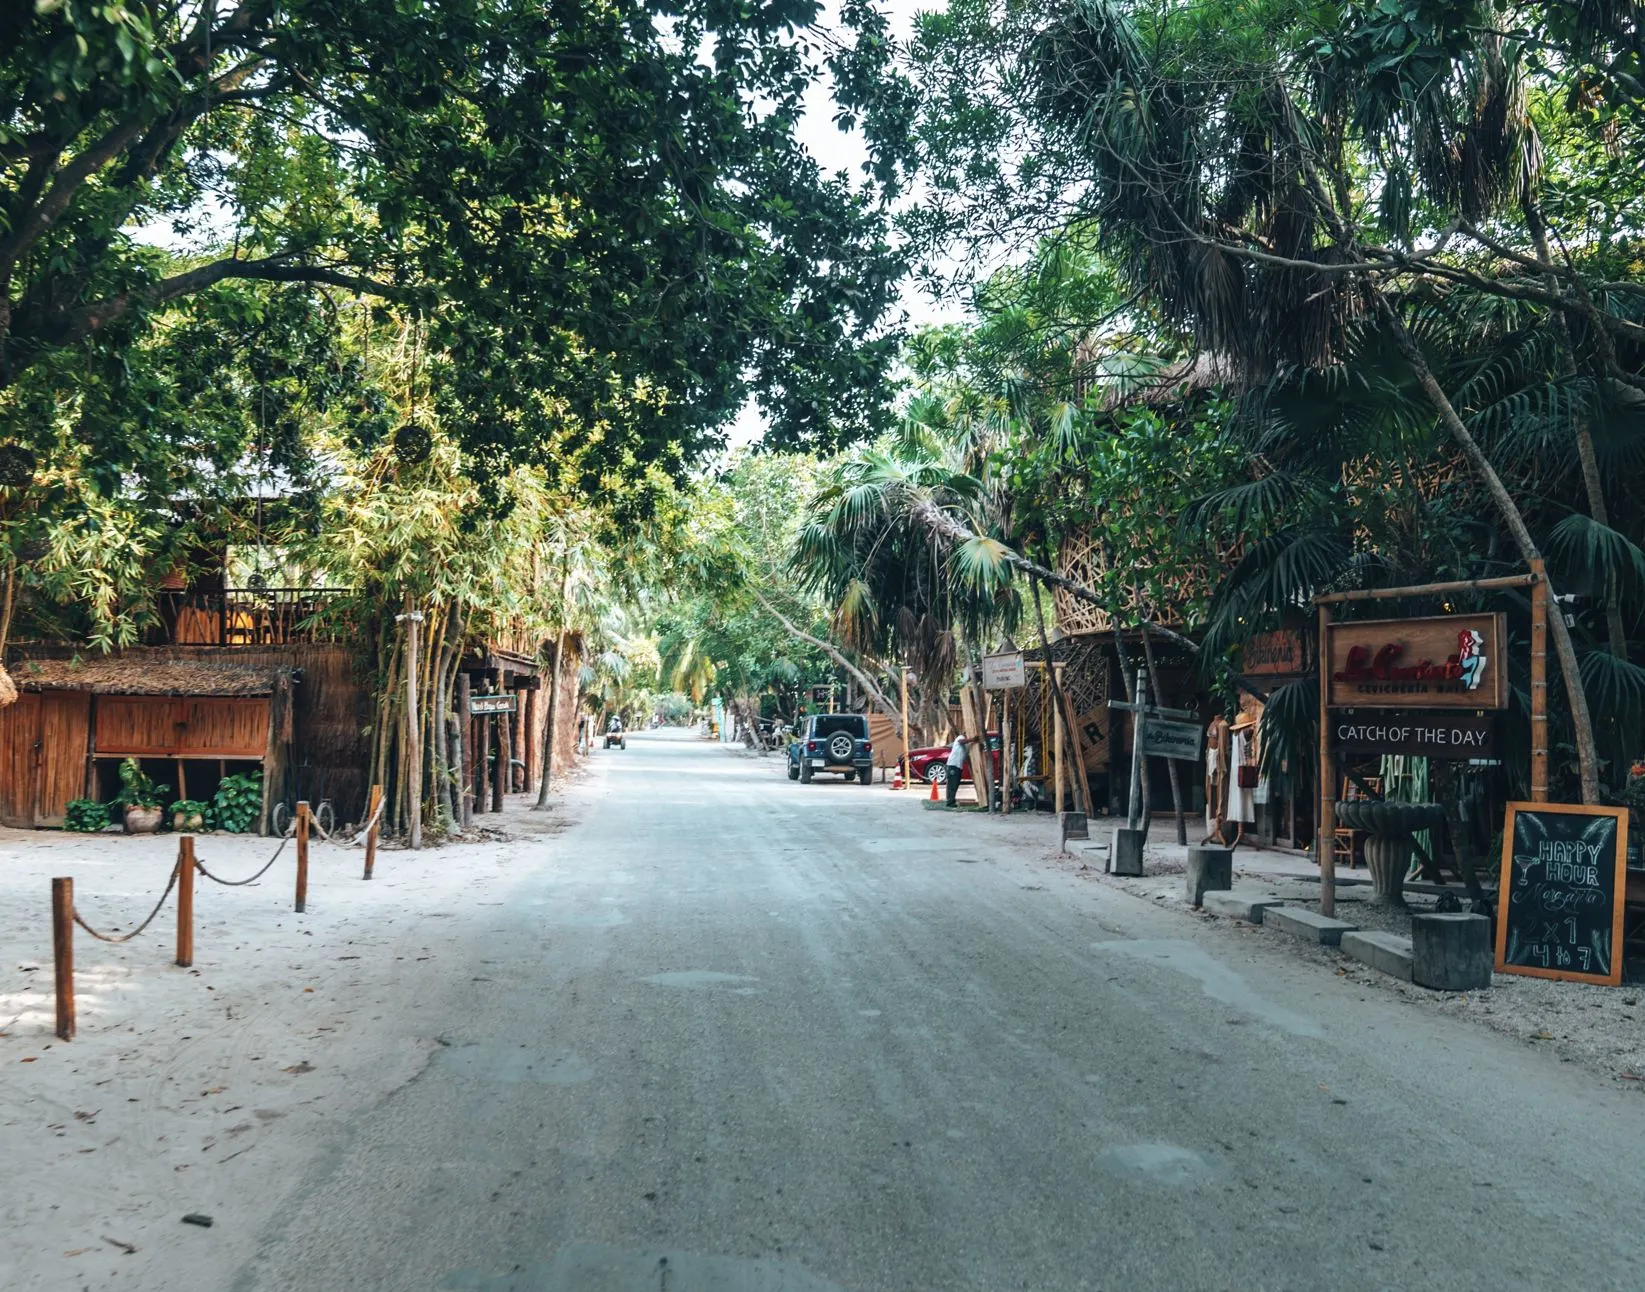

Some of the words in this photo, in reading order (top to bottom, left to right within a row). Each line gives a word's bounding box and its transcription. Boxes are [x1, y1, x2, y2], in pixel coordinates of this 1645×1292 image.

[1338, 725, 1387, 741] CATCH
[1388, 727, 1411, 742] OF
[1414, 728, 1447, 744] THE
[1451, 729, 1487, 746] DAY
[1539, 840, 1601, 865] HAPPY
[1546, 862, 1600, 886] HOUR
[1532, 944, 1550, 967] 4
[1555, 945, 1571, 965] to
[1577, 946, 1592, 970] 7
